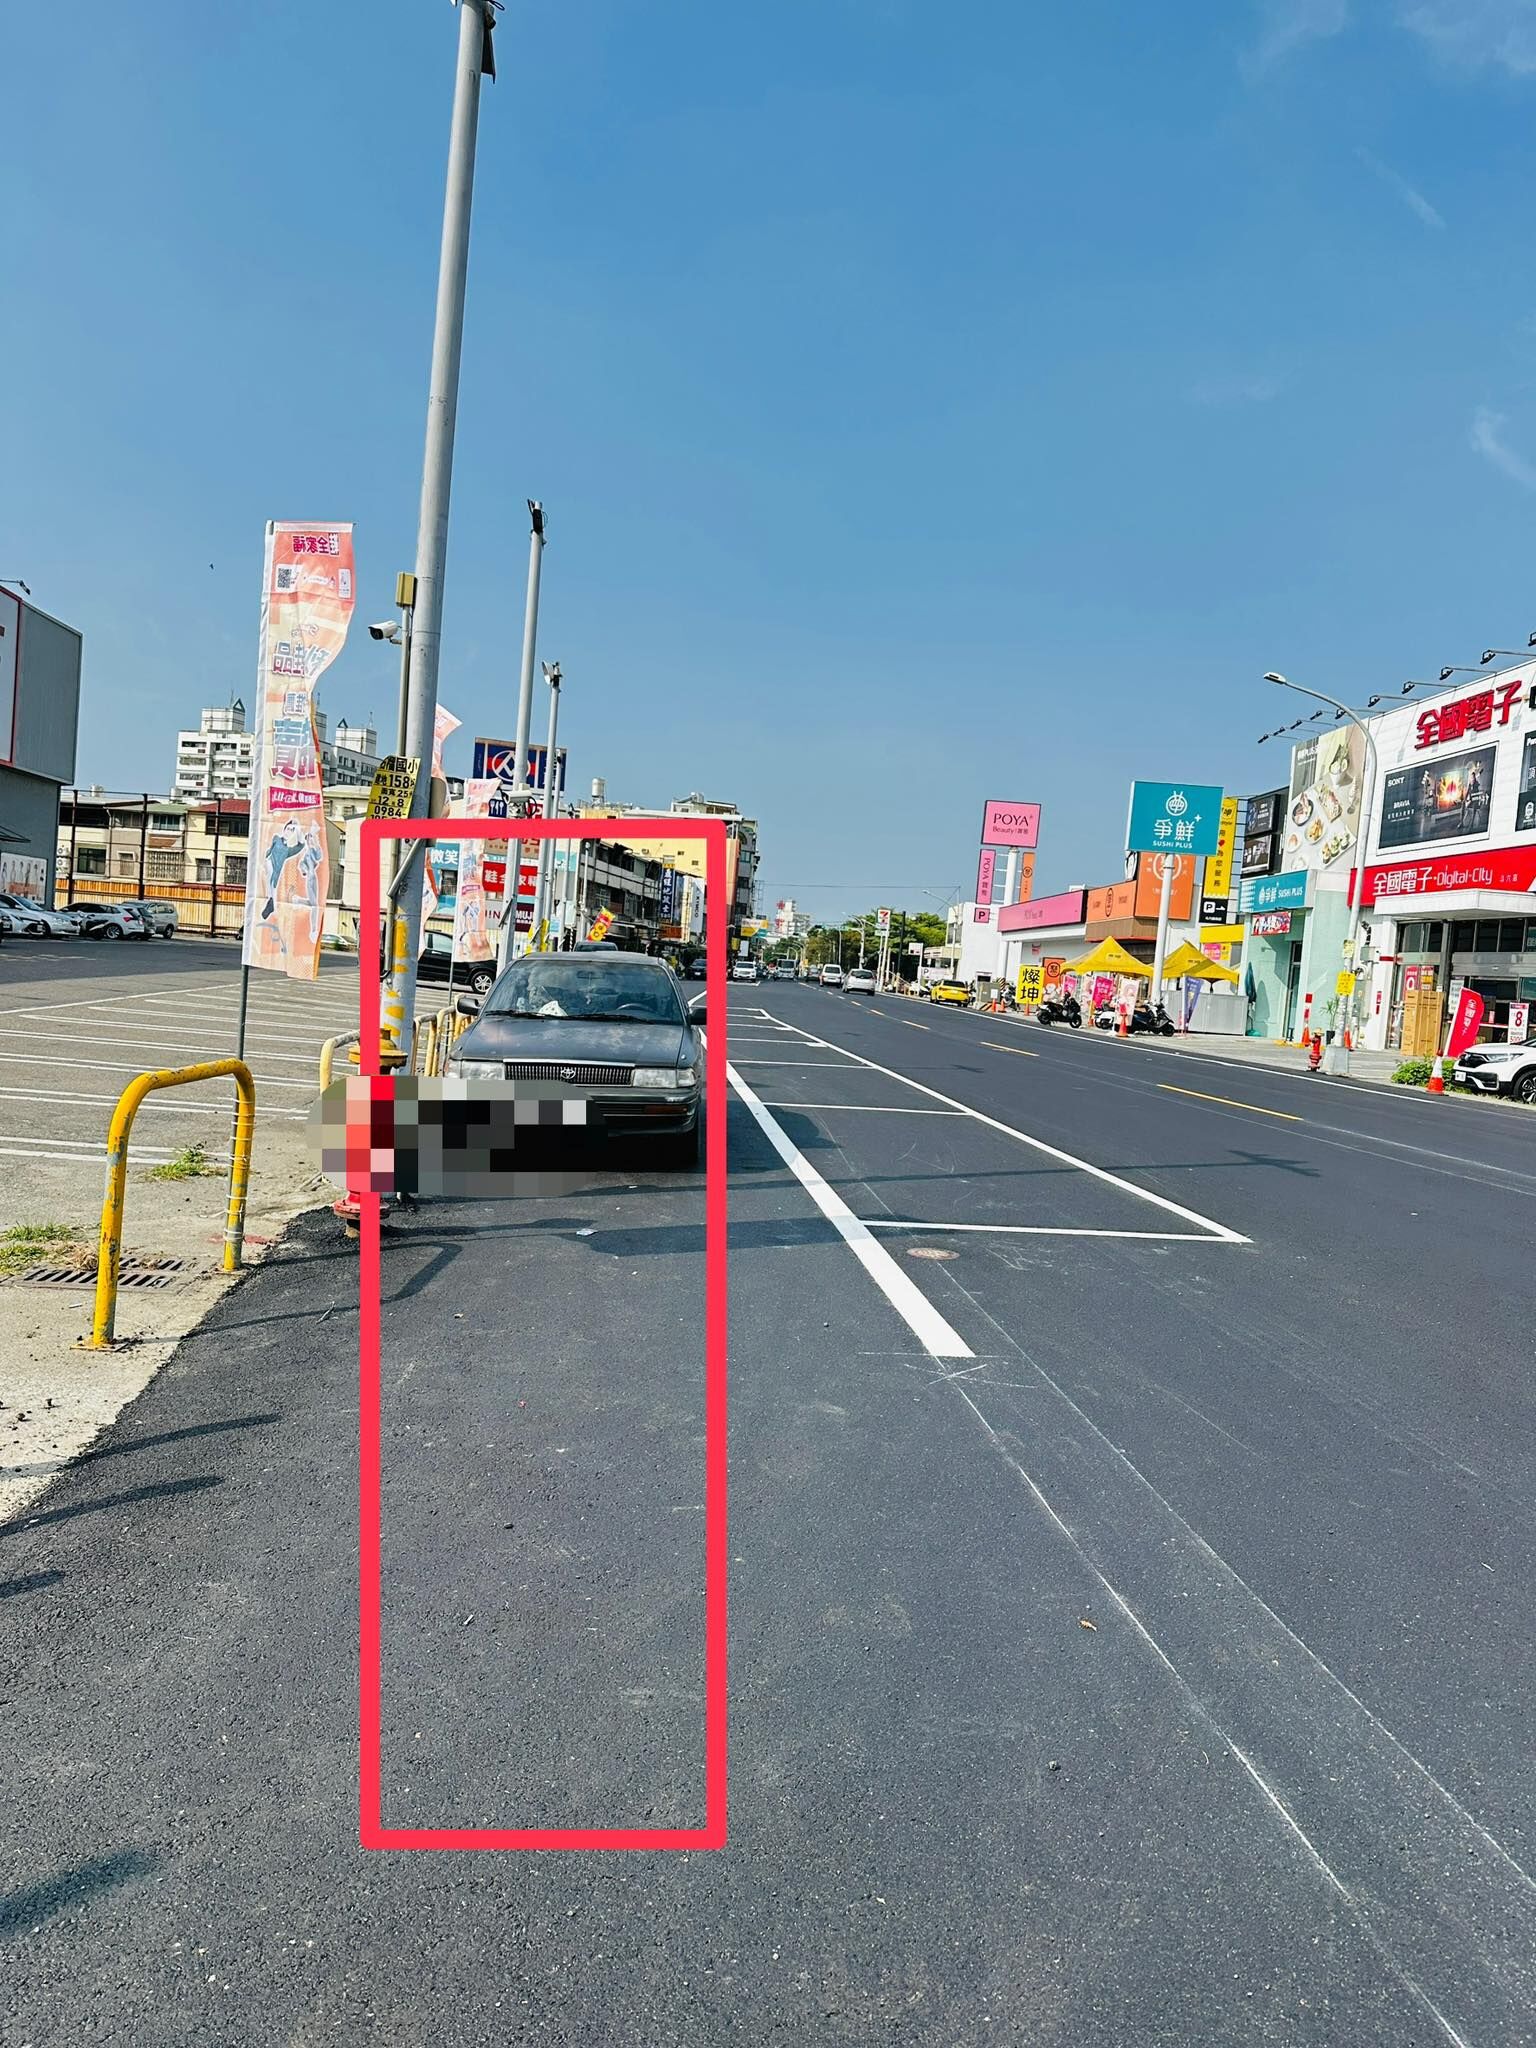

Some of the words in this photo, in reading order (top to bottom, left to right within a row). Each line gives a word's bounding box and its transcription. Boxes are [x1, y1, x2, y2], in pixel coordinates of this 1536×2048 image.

[1414, 680, 1523, 750] 全國電子
[1387, 776, 1405, 787] SONY
[993, 813, 1029, 827] POYA
[992, 825, 1015, 835] Beauty
[1153, 818, 1195, 842] 爭鮮
[1152, 840, 1174, 848] SUSHI
[1174, 841, 1193, 849] PLUS
[429, 848, 459, 866] 微笑
[982, 857, 991, 880] POYA
[1373, 866, 1433, 896] 全國電子
[977, 911, 986, 920] P
[1020, 968, 1041, 1002] 燦坤
[1514, 1010, 1523, 1027] 8
